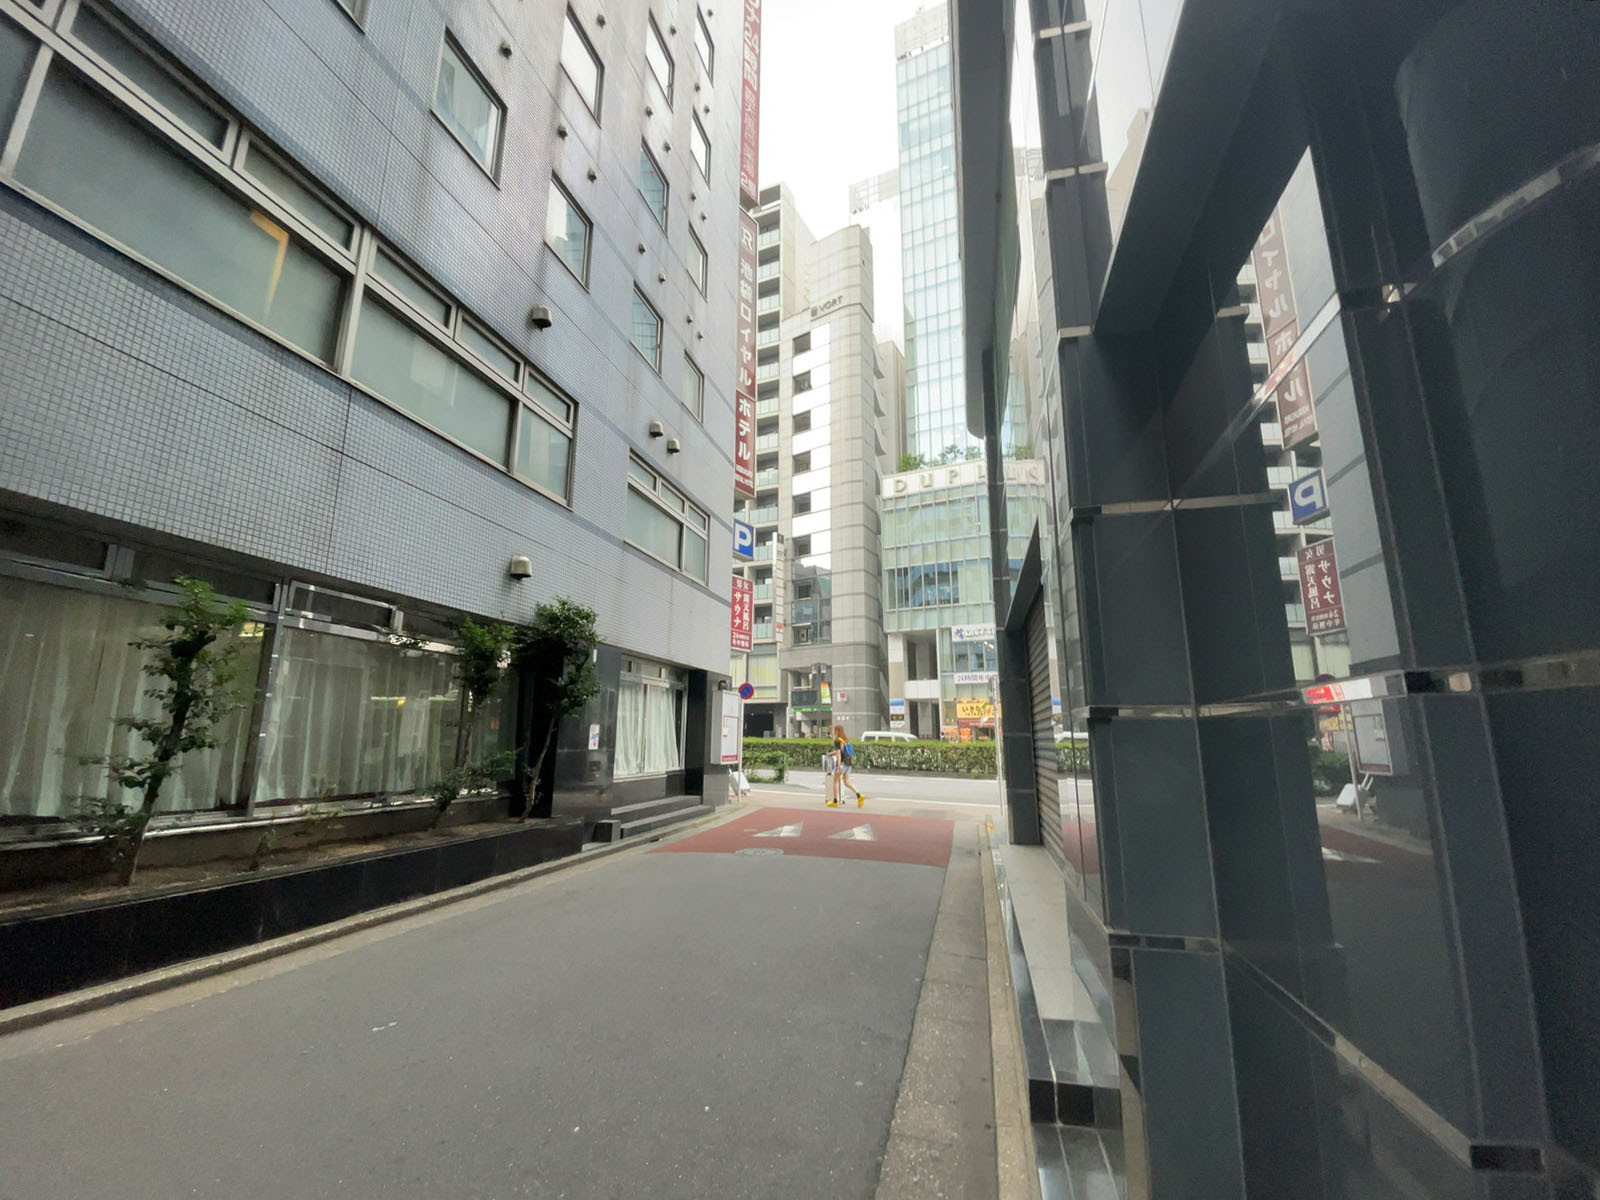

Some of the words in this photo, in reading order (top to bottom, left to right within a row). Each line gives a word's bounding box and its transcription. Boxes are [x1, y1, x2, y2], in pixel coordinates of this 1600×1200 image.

[739, 257, 753, 387] 池袋ロイヤル
[737, 397, 751, 462] ホテル
[734, 522, 752, 551] P
[733, 591, 742, 628] サウナ
